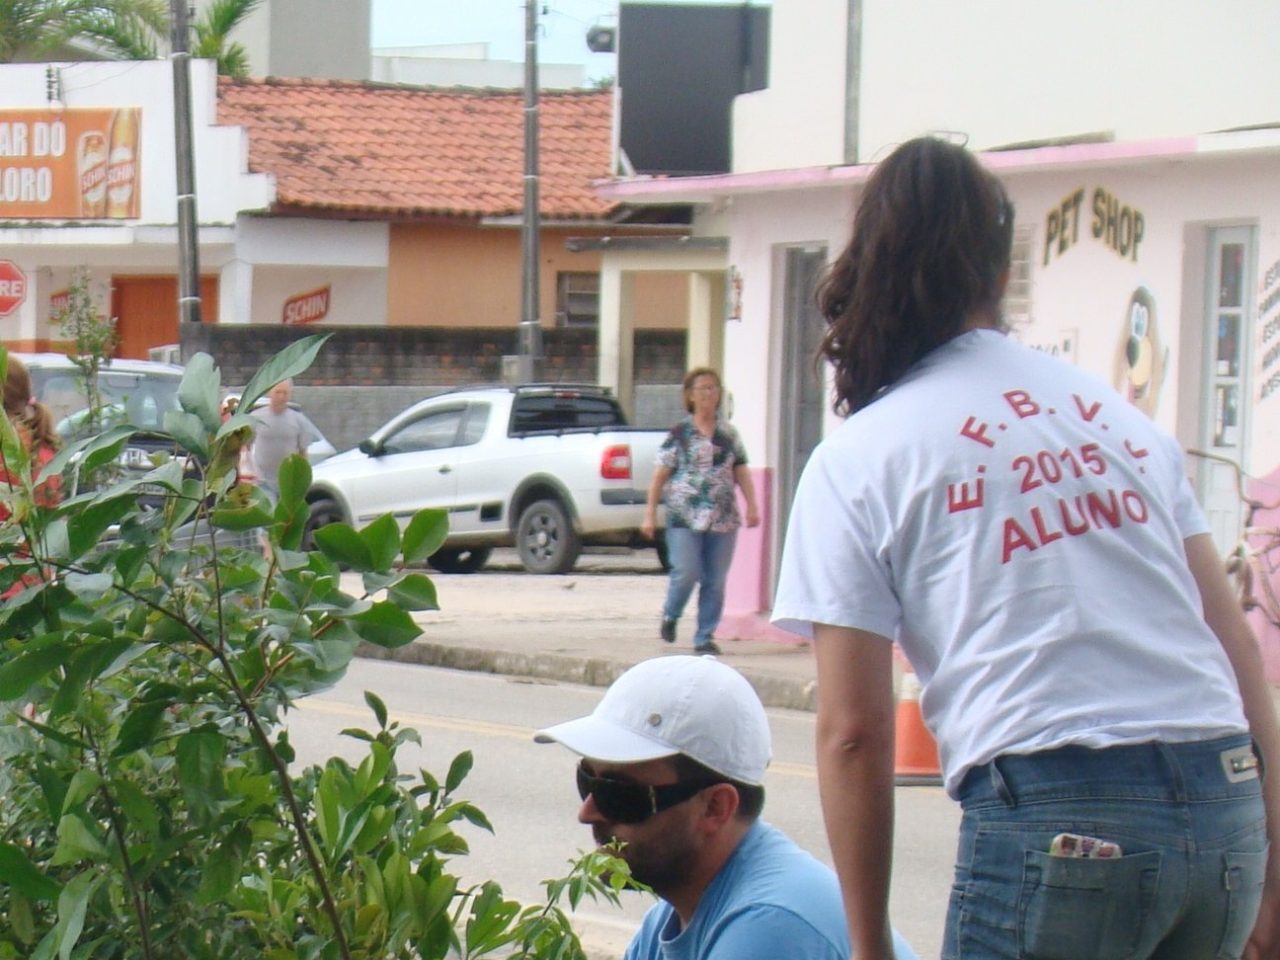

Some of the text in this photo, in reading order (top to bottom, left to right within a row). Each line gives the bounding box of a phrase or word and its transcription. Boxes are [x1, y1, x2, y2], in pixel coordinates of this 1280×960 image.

[33, 121, 66, 157] DO
[1043, 188, 1144, 267] PET SHOP
[285, 292, 327, 324] SCHIN
[1012, 442, 1107, 494] 2015
[1001, 489, 1148, 565] ALUNO
